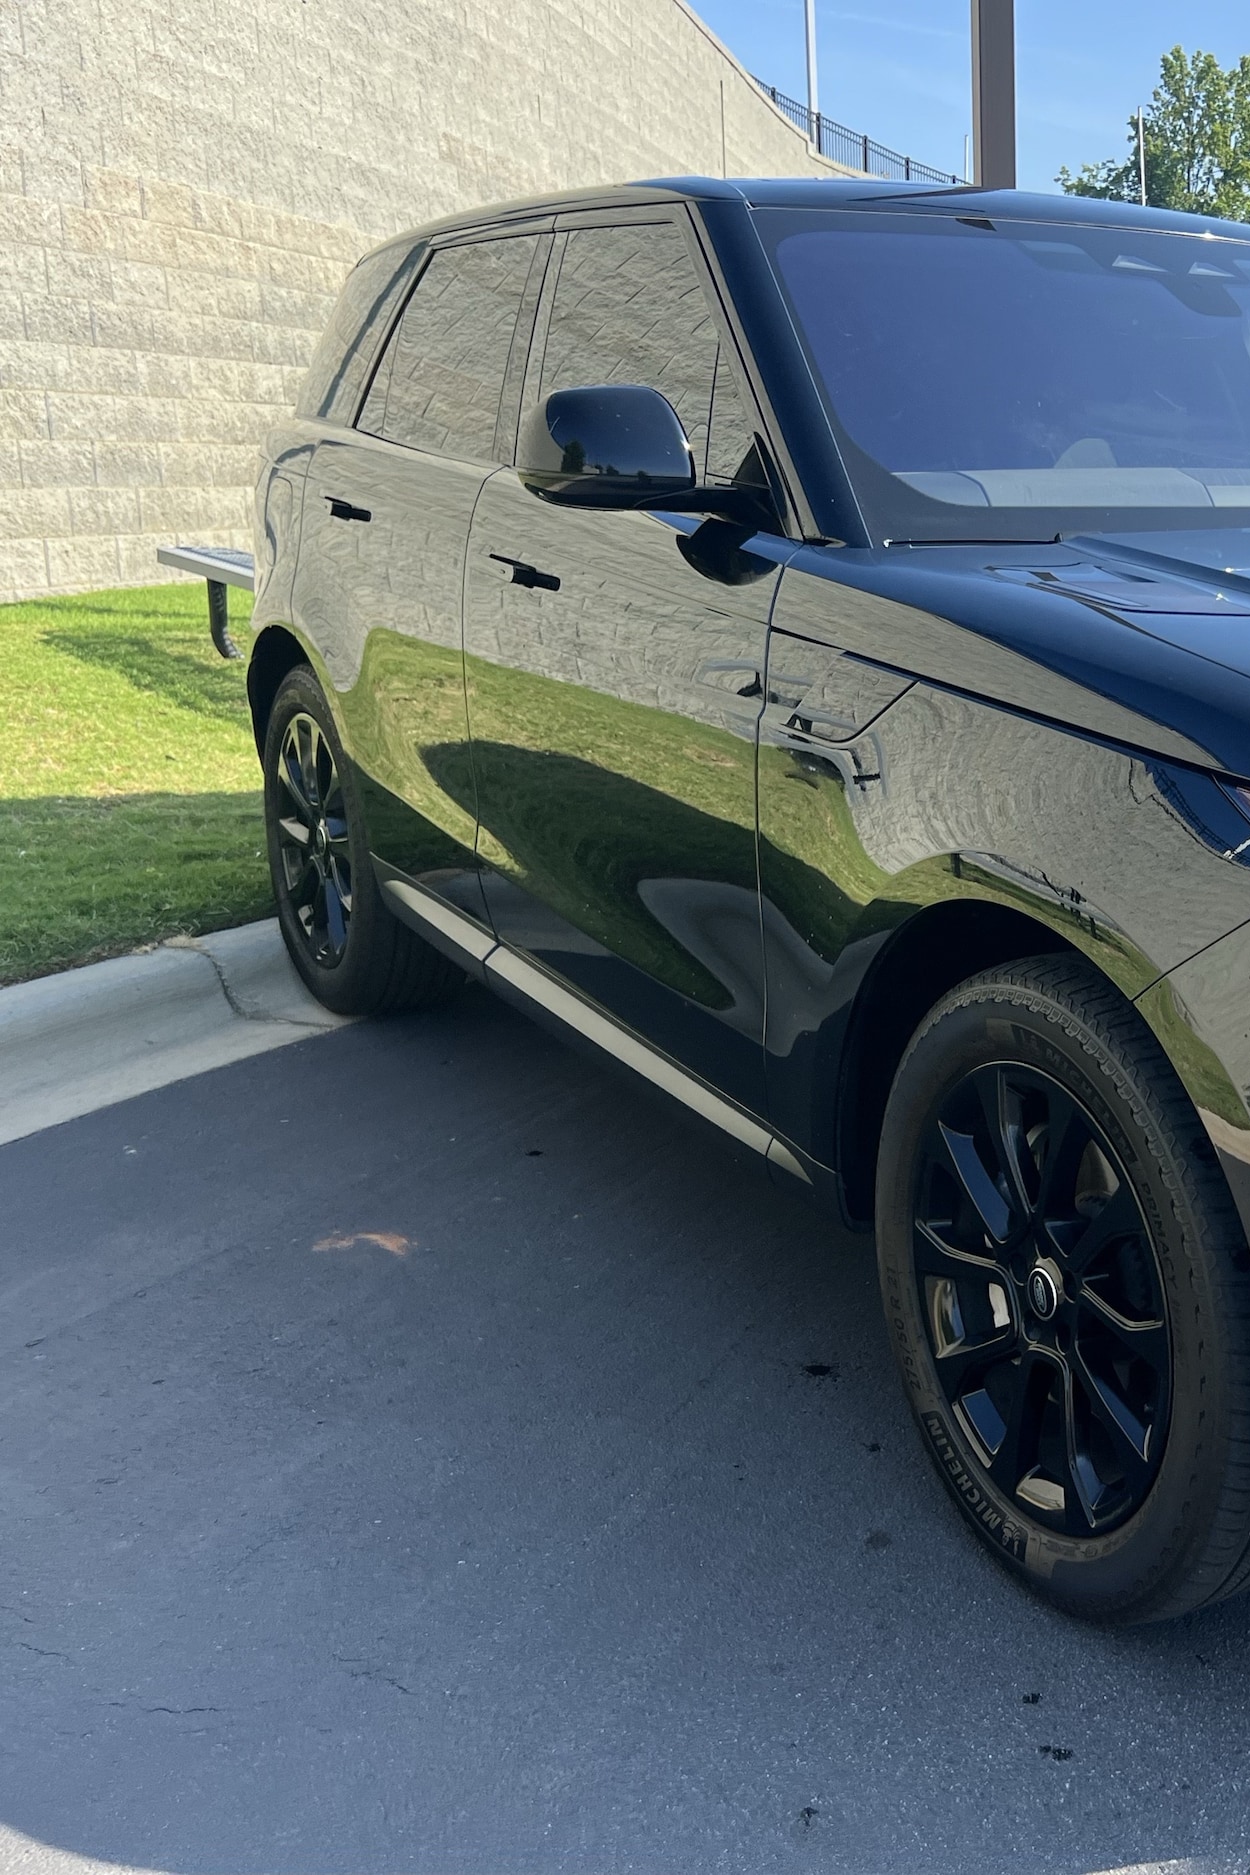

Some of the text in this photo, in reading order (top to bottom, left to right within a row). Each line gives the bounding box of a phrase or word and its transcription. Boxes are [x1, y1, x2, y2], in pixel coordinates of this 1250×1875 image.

[1140, 1181, 1178, 1290] PRIMACY
[889, 1295, 902, 1311] R
[893, 1317, 922, 1391] 275/50
[926, 1417, 1002, 1531] MICHELIN
